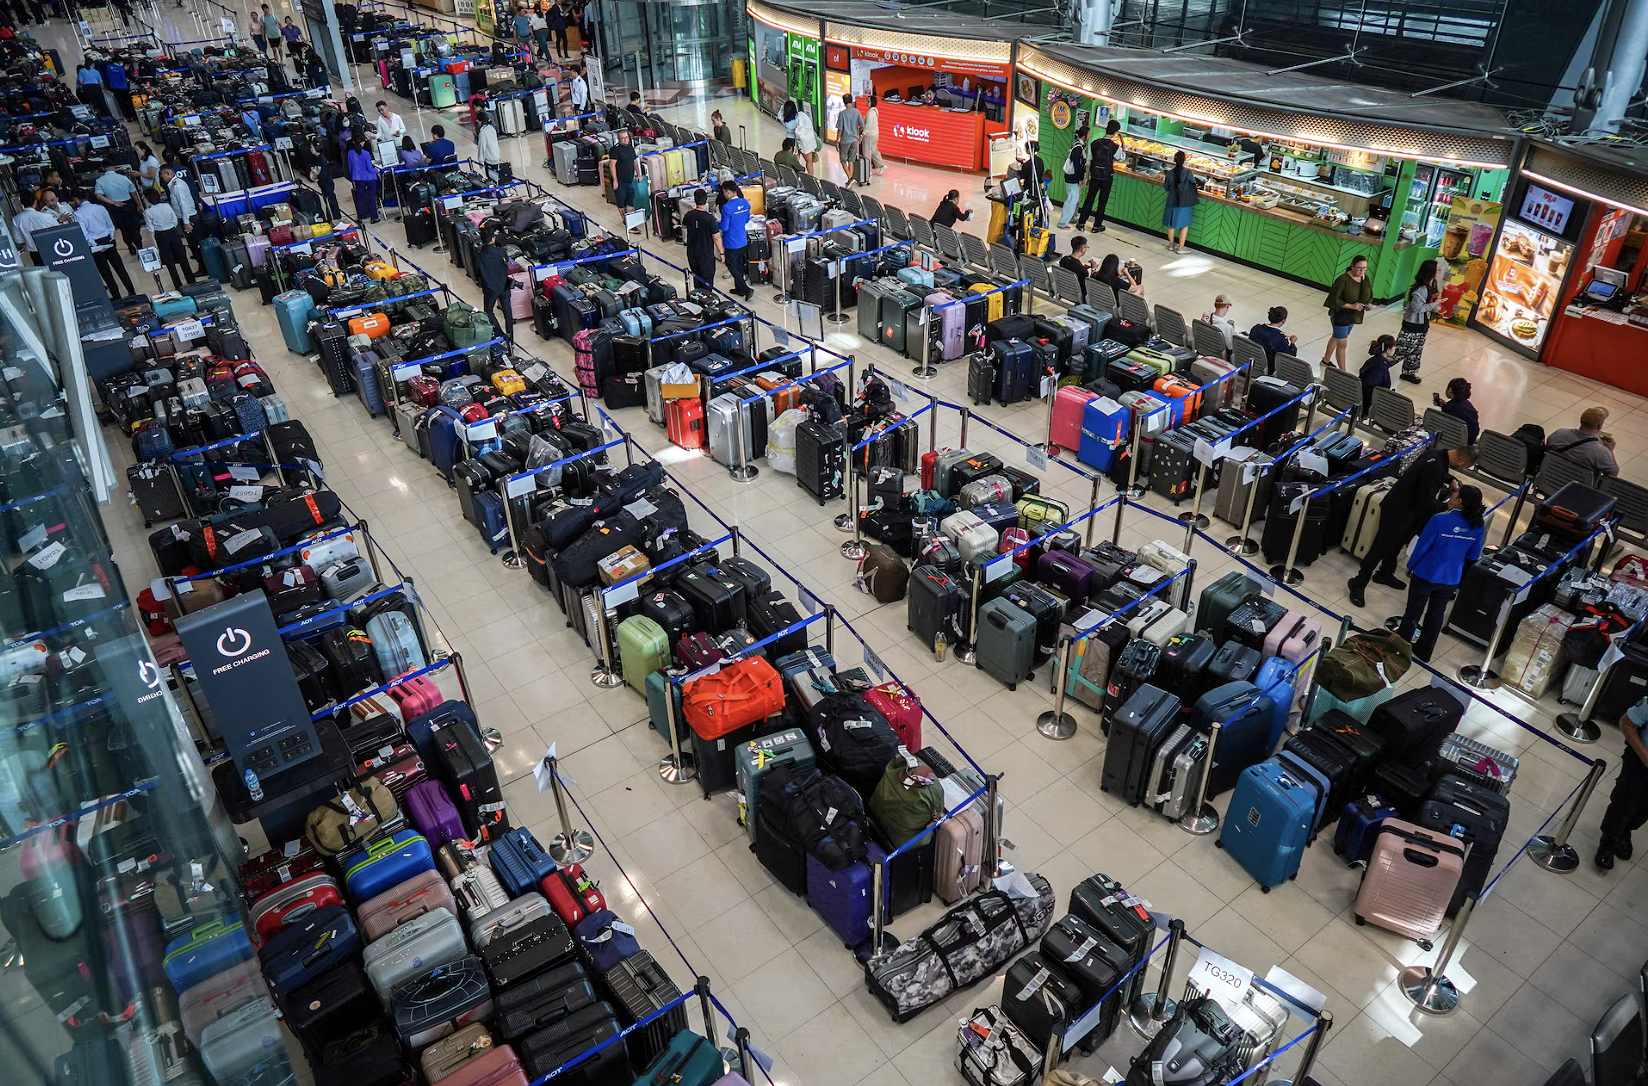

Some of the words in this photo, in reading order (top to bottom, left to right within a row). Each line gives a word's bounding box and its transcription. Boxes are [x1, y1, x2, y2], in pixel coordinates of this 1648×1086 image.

[792, 40, 801, 50] ATM
[806, 44, 815, 53] ATM
[864, 50, 878, 58] klook
[906, 125, 929, 138] klook
[175, 169, 187, 179] OT
[689, 549, 701, 557] AOT
[778, 629, 788, 637] AOT
[212, 663, 233, 675] FREE
[232, 648, 271, 668] CHARGING
[391, 679, 403, 687] AOT
[333, 703, 346, 711] AOT
[210, 753, 224, 762] AOT
[936, 815, 949, 826] AOT
[886, 850, 898, 862] AOT
[1205, 960, 1243, 988] TG320
[620, 1024, 637, 1037] AOT
[1254, 1057, 1270, 1070] AOT
[545, 1067, 562, 1081] AOT
